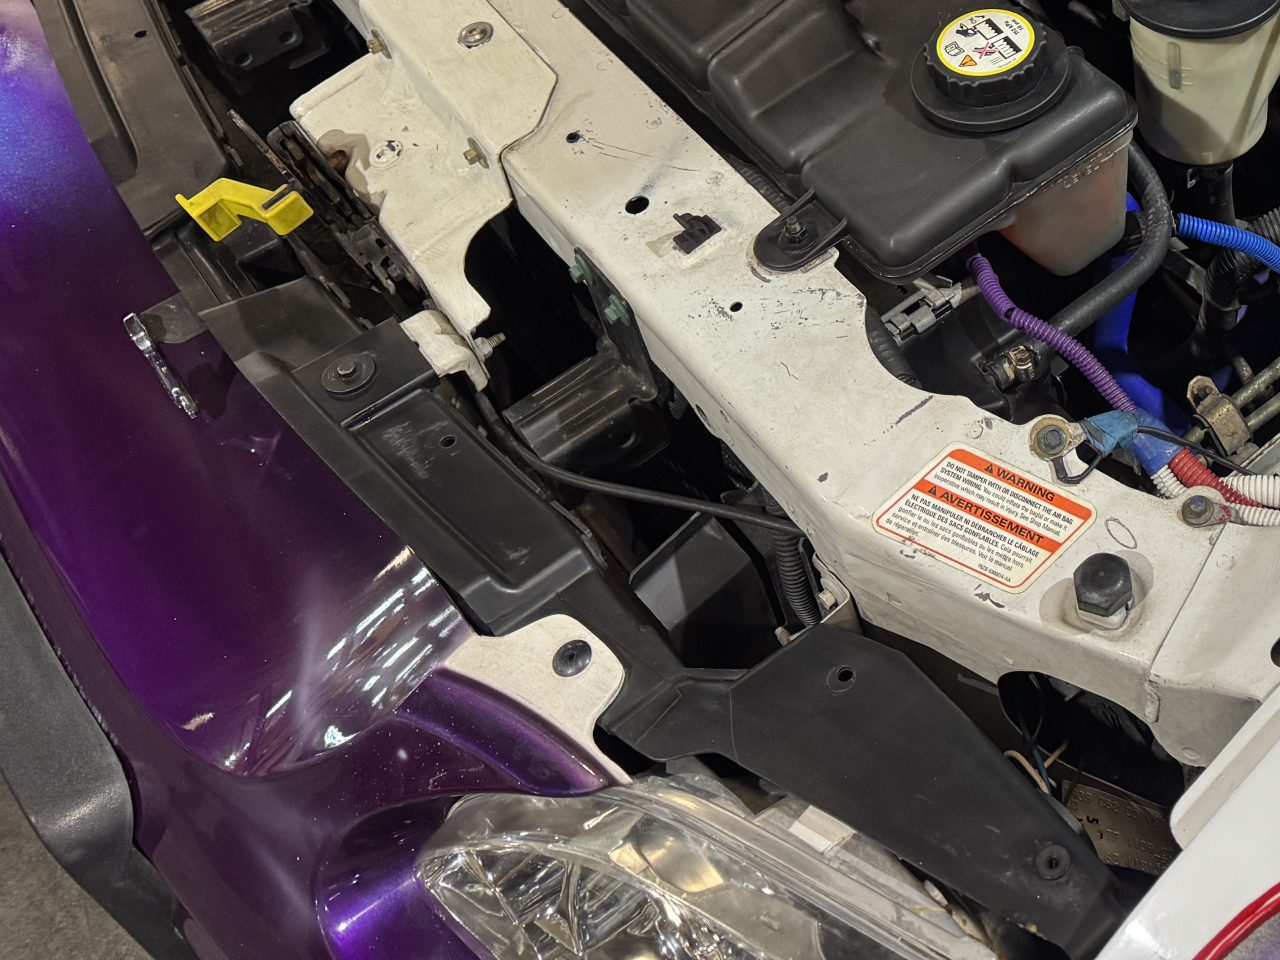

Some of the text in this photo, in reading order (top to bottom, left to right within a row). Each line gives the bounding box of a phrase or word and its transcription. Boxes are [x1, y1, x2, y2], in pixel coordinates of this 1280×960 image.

[940, 468, 961, 480] SYSTEM
[994, 468, 1056, 501] WARNING
[954, 465, 966, 473] NOT
[966, 471, 987, 484] TAMPER
[987, 481, 1002, 490] WITH
[1009, 491, 1042, 509] DISCONNECT
[1041, 506, 1052, 514] THE
[1051, 511, 1062, 519] AIR
[1061, 516, 1073, 524] BAG
[919, 498, 931, 506] PAS
[930, 503, 964, 521] MANIPULER
[936, 515, 948, 523] DES
[948, 520, 964, 530] SACS
[938, 491, 1044, 544] AVERTISSEMENT
